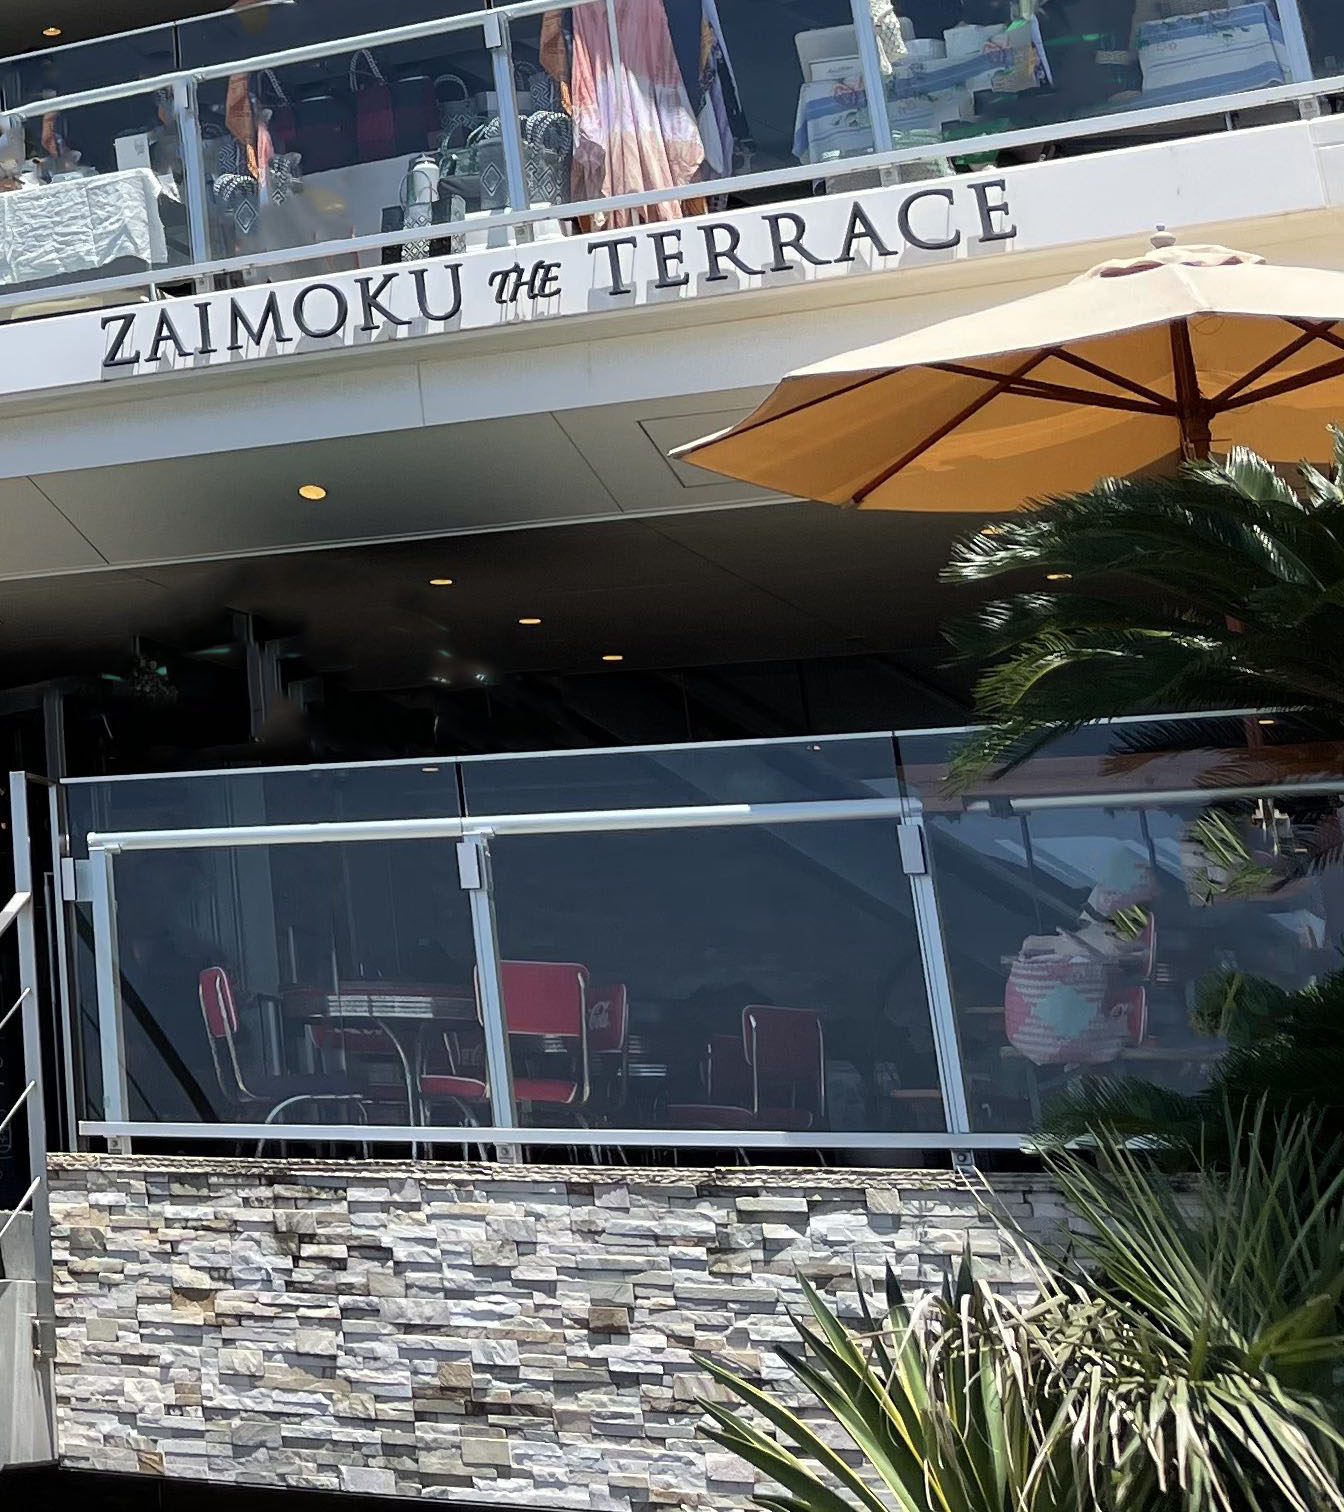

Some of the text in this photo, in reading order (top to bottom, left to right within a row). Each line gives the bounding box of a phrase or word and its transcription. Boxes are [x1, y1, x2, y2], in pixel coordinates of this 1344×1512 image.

[100, 178, 1018, 368] ZAIMOKU THE TERRACE
